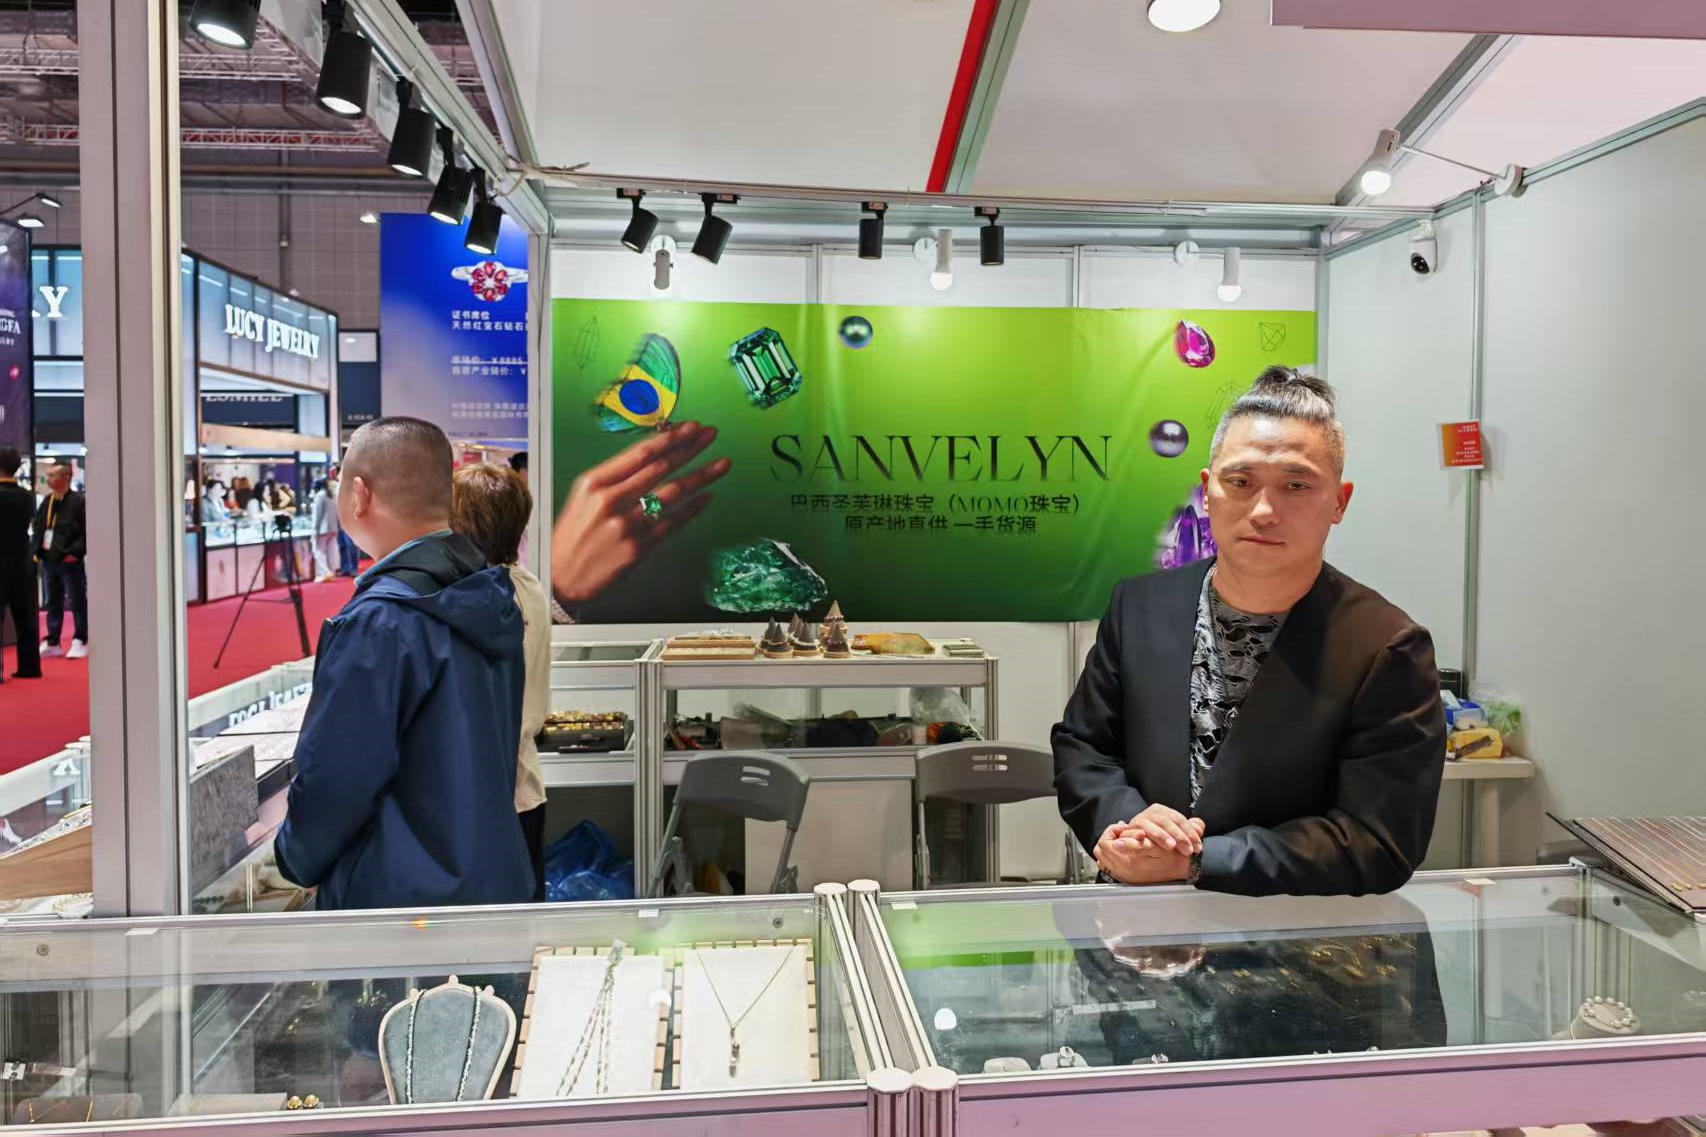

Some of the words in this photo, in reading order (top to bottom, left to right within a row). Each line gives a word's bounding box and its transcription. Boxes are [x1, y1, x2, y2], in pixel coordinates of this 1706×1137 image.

[224, 303, 265, 342] LUCY
[264, 318, 320, 361] JEWELRY
[452, 320, 528, 331] 天然红宝石钻石
[770, 434, 1112, 482] SANVELYN
